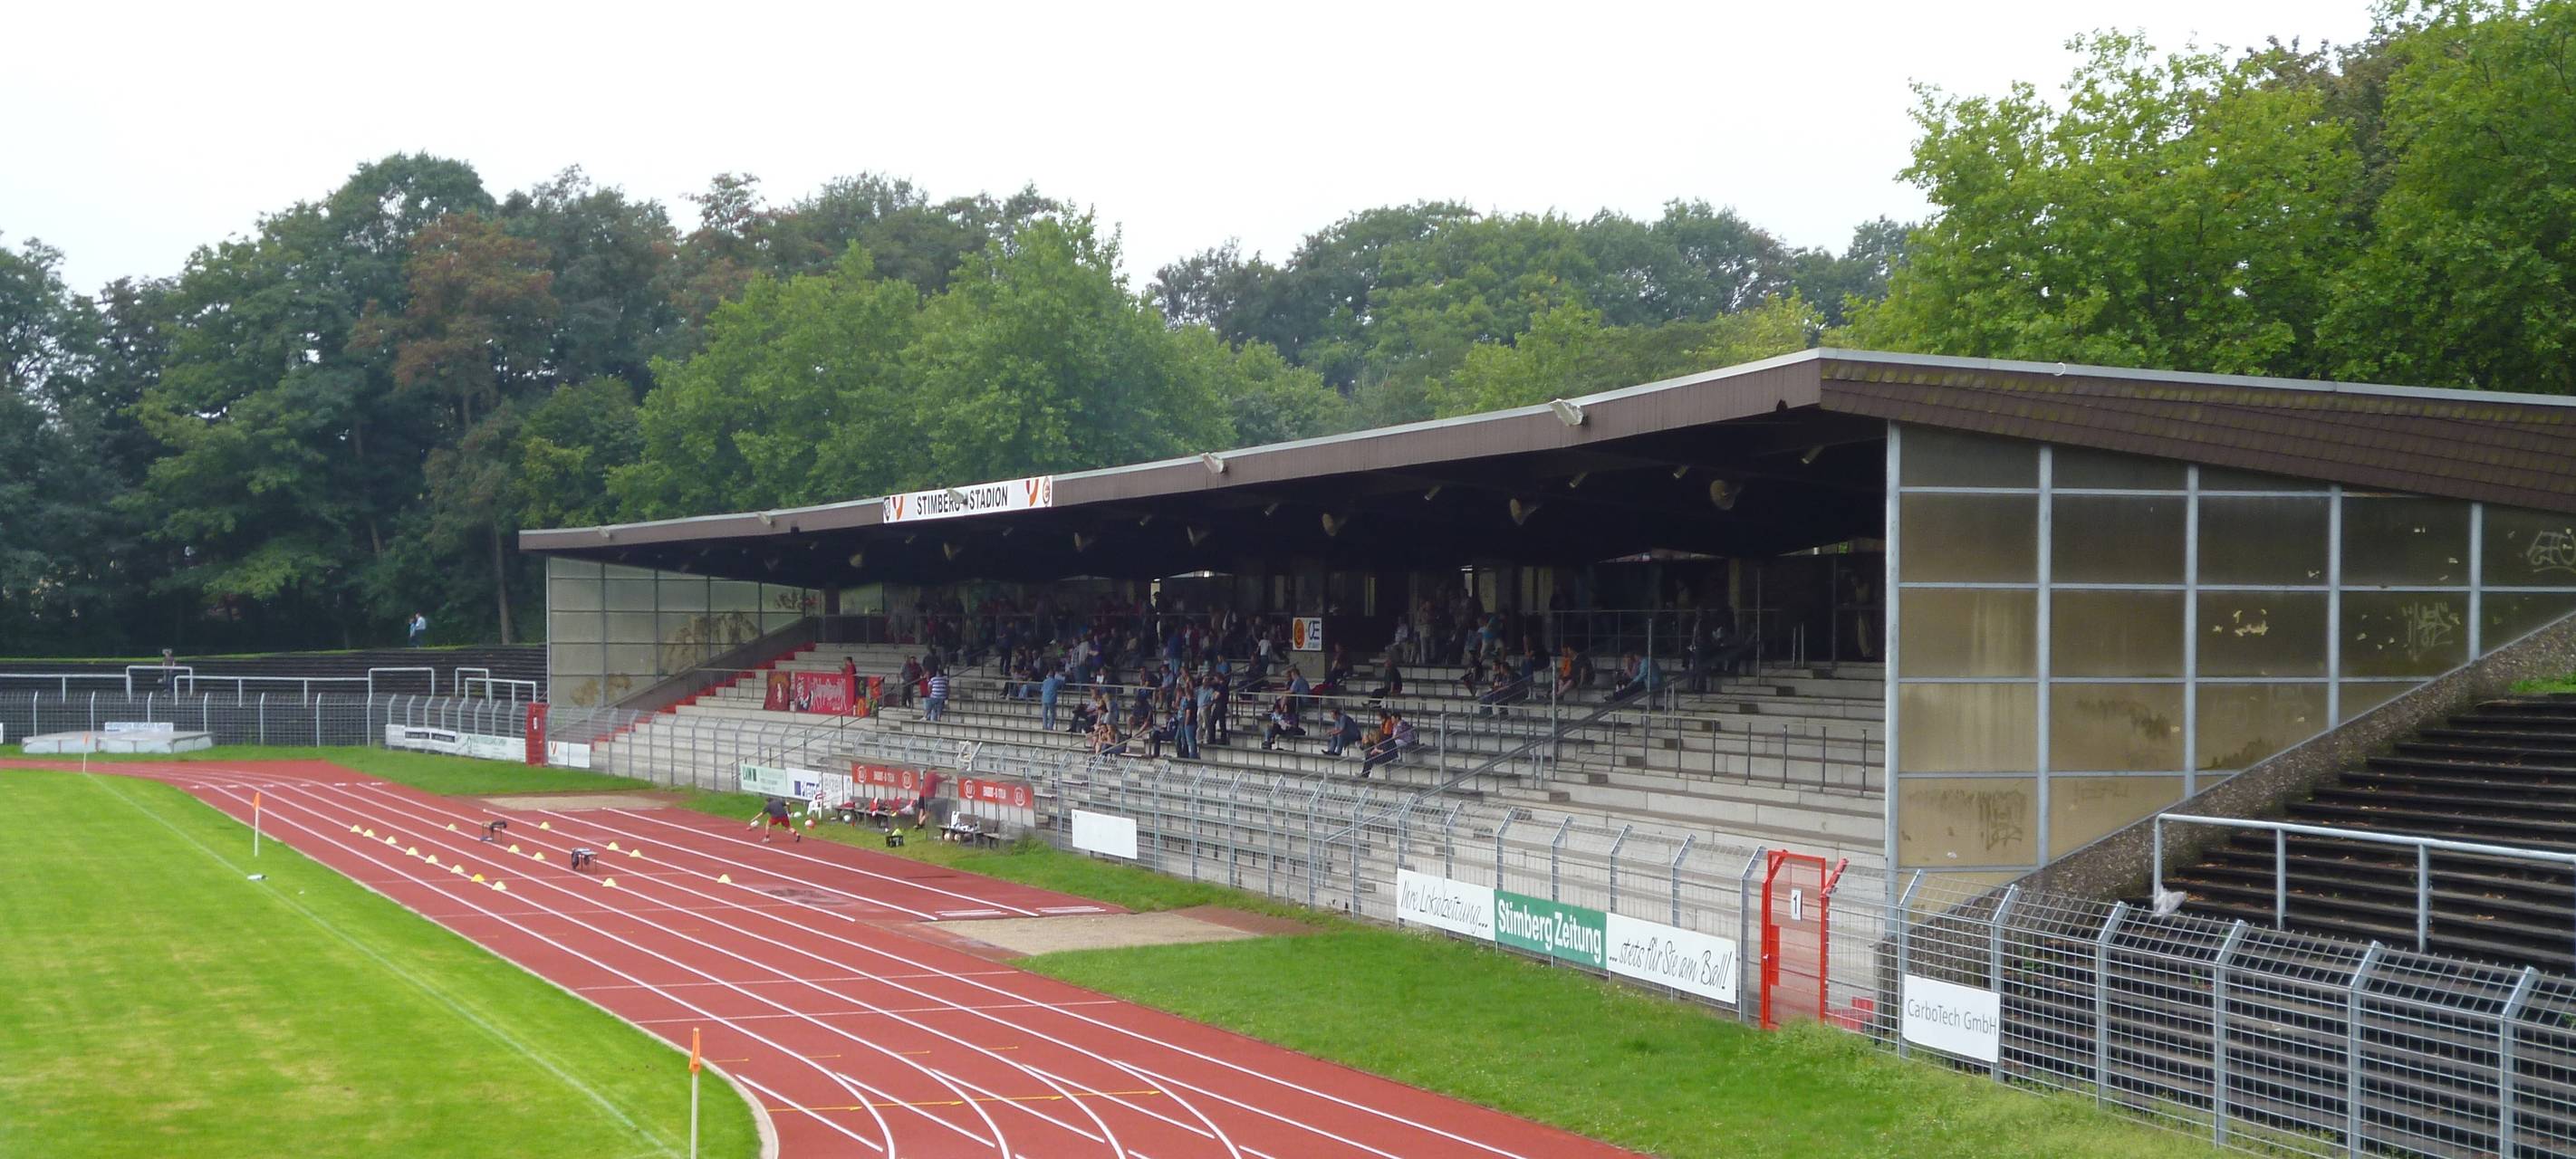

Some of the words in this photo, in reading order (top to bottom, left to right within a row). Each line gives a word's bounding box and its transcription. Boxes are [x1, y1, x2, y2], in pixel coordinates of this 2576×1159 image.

[969, 485, 1008, 510] STADION
[1400, 880, 1418, 911] Ihre
[1793, 894, 1798, 915] 1
[1498, 898, 1552, 952] Stimberg
[1554, 911, 1601, 963] Zeitung
[1644, 936, 1663, 972] für
[1662, 940, 1678, 977] Sie
[1678, 955, 1698, 982] am
[1700, 949, 1732, 990] Ball!
[1908, 999, 1960, 1027] CarboTech
[1964, 1011, 1997, 1037] GmbH
